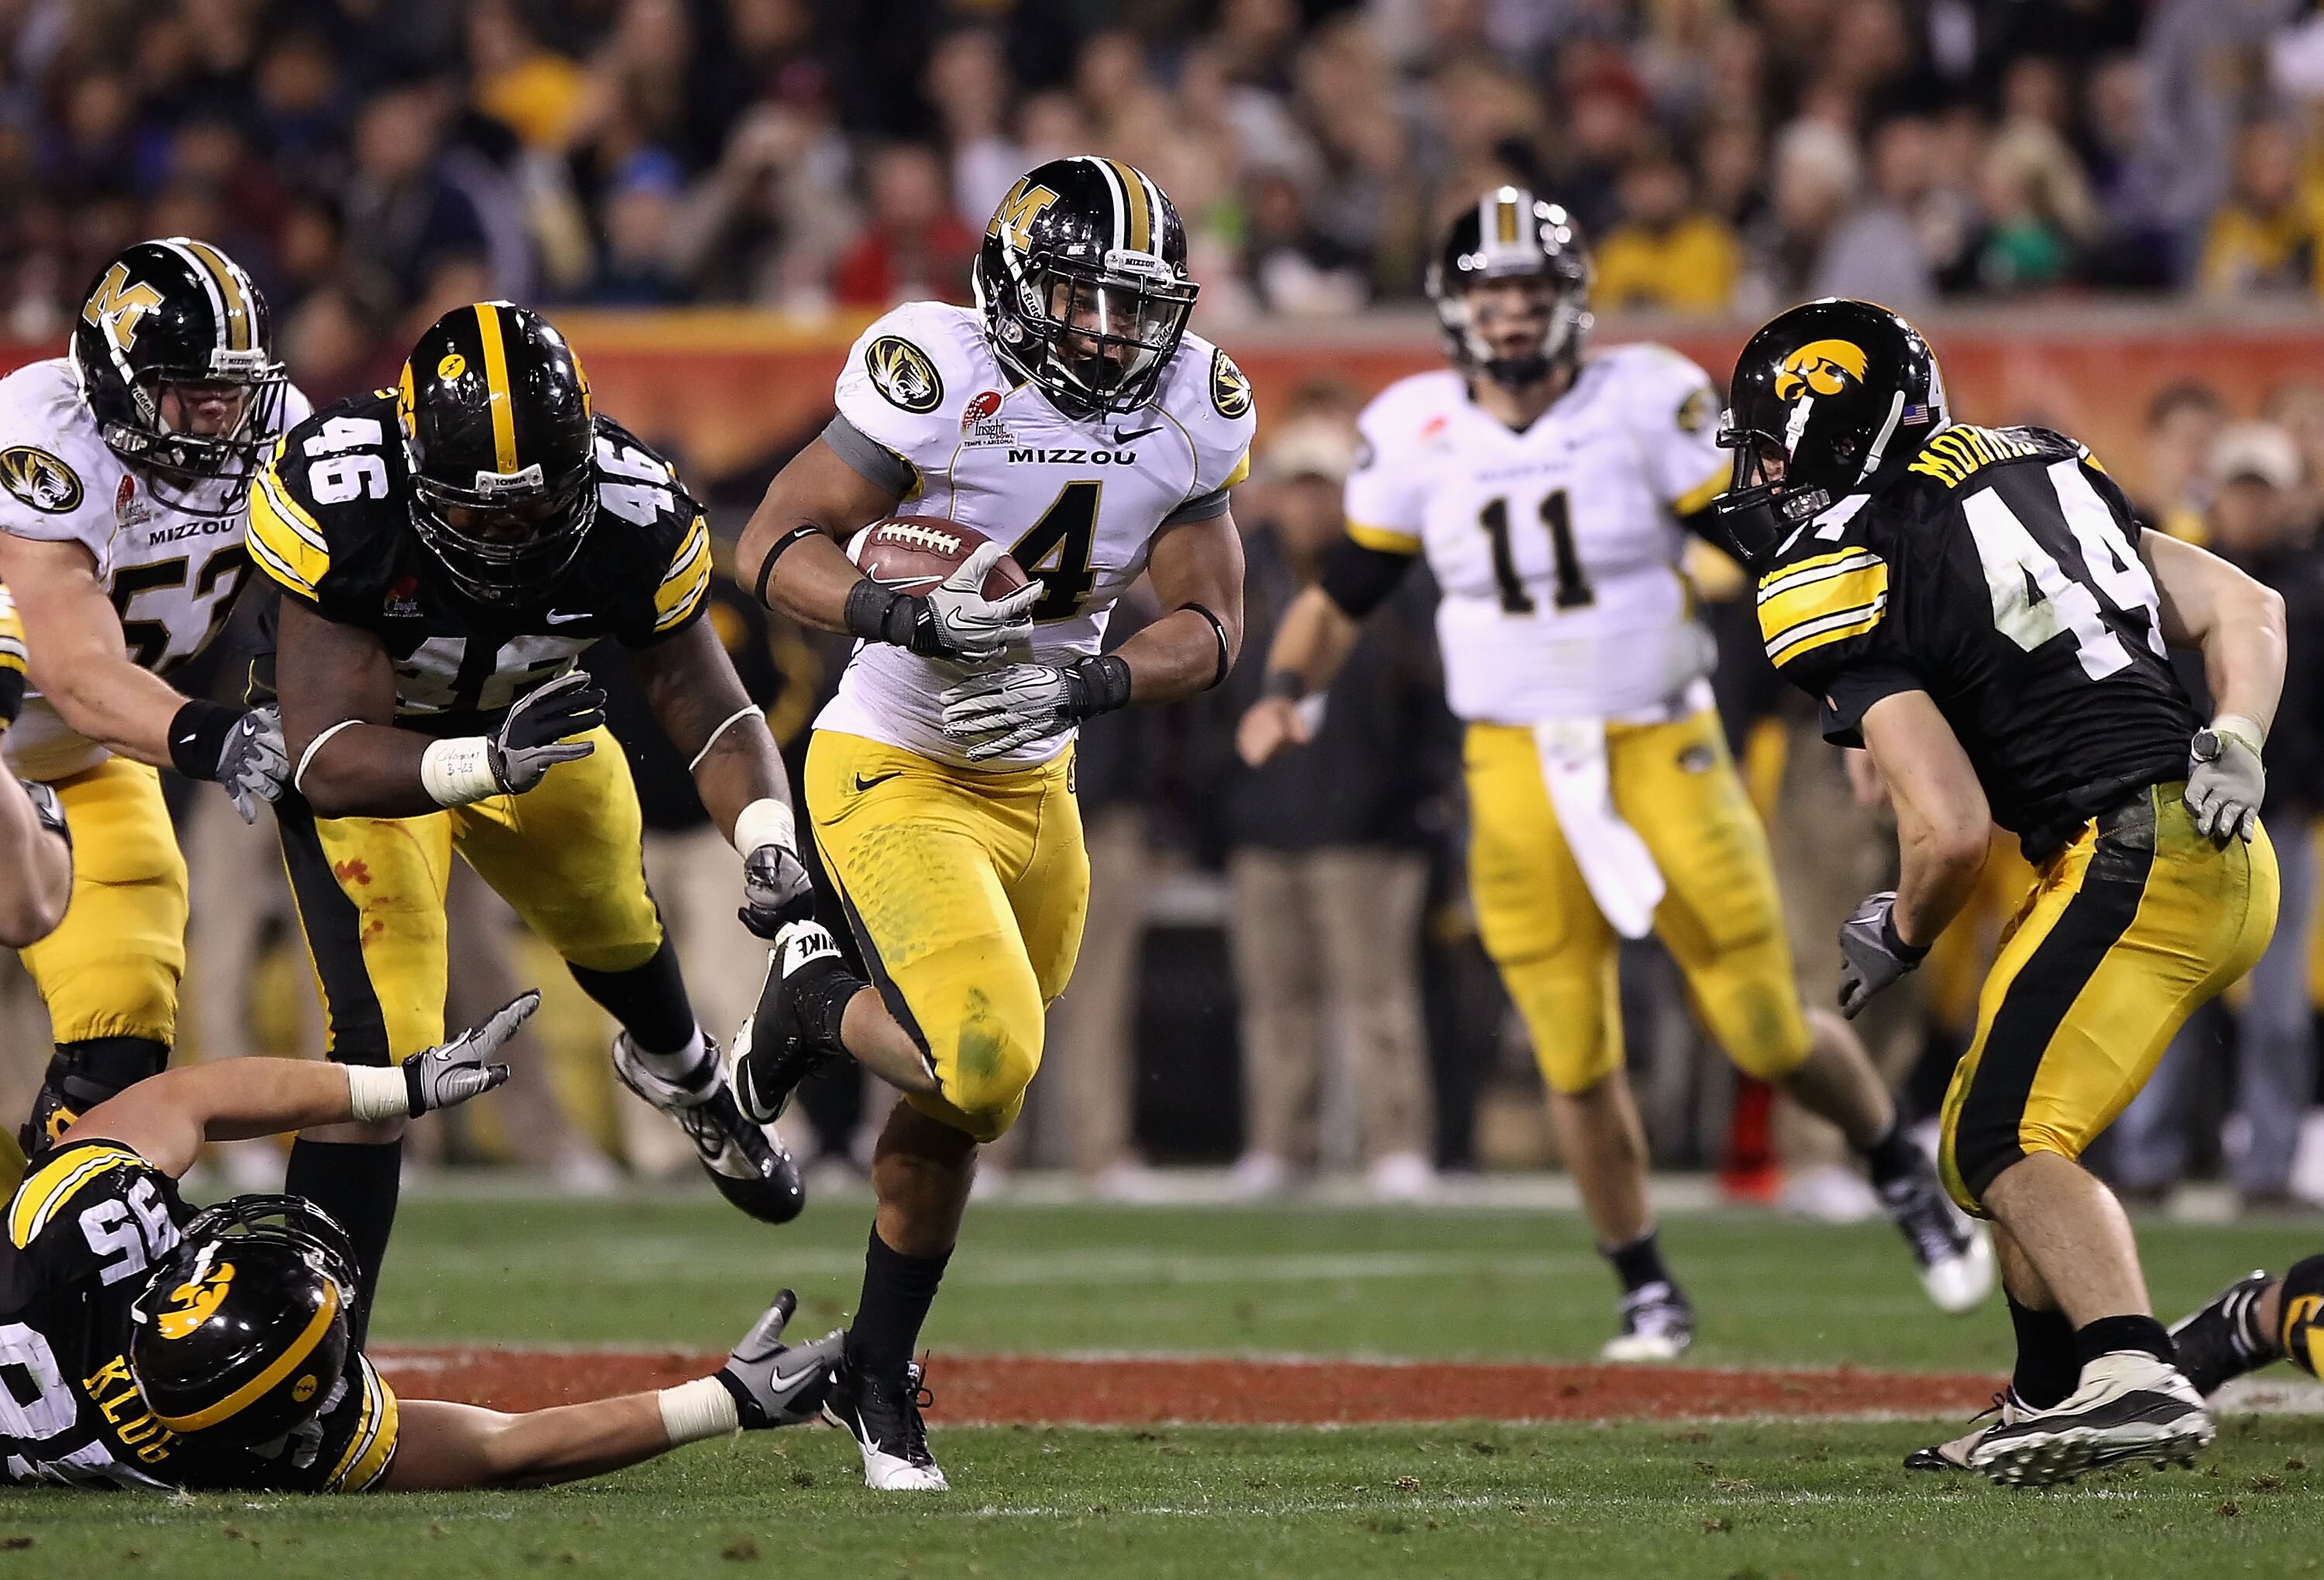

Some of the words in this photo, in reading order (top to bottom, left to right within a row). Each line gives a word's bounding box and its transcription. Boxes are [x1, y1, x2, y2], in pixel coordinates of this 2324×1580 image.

[985, 175, 1061, 255] M
[1067, 245, 1087, 256] NIKE
[1125, 258, 1156, 267] MIZZOU
[82, 261, 165, 353] M
[1023, 292, 1042, 318] Ridd
[303, 416, 388, 505] 46
[975, 419, 1007, 439] Insight
[1009, 449, 1136, 466] MIZZOU
[495, 476, 527, 486] IOWA
[595, 436, 675, 527] 46
[150, 519, 235, 546] MIZZOU
[1007, 480, 1103, 625] 4
[1478, 486, 1596, 613] 11
[1962, 457, 2169, 682] 44
[82, 1354, 178, 1464] KLUG
